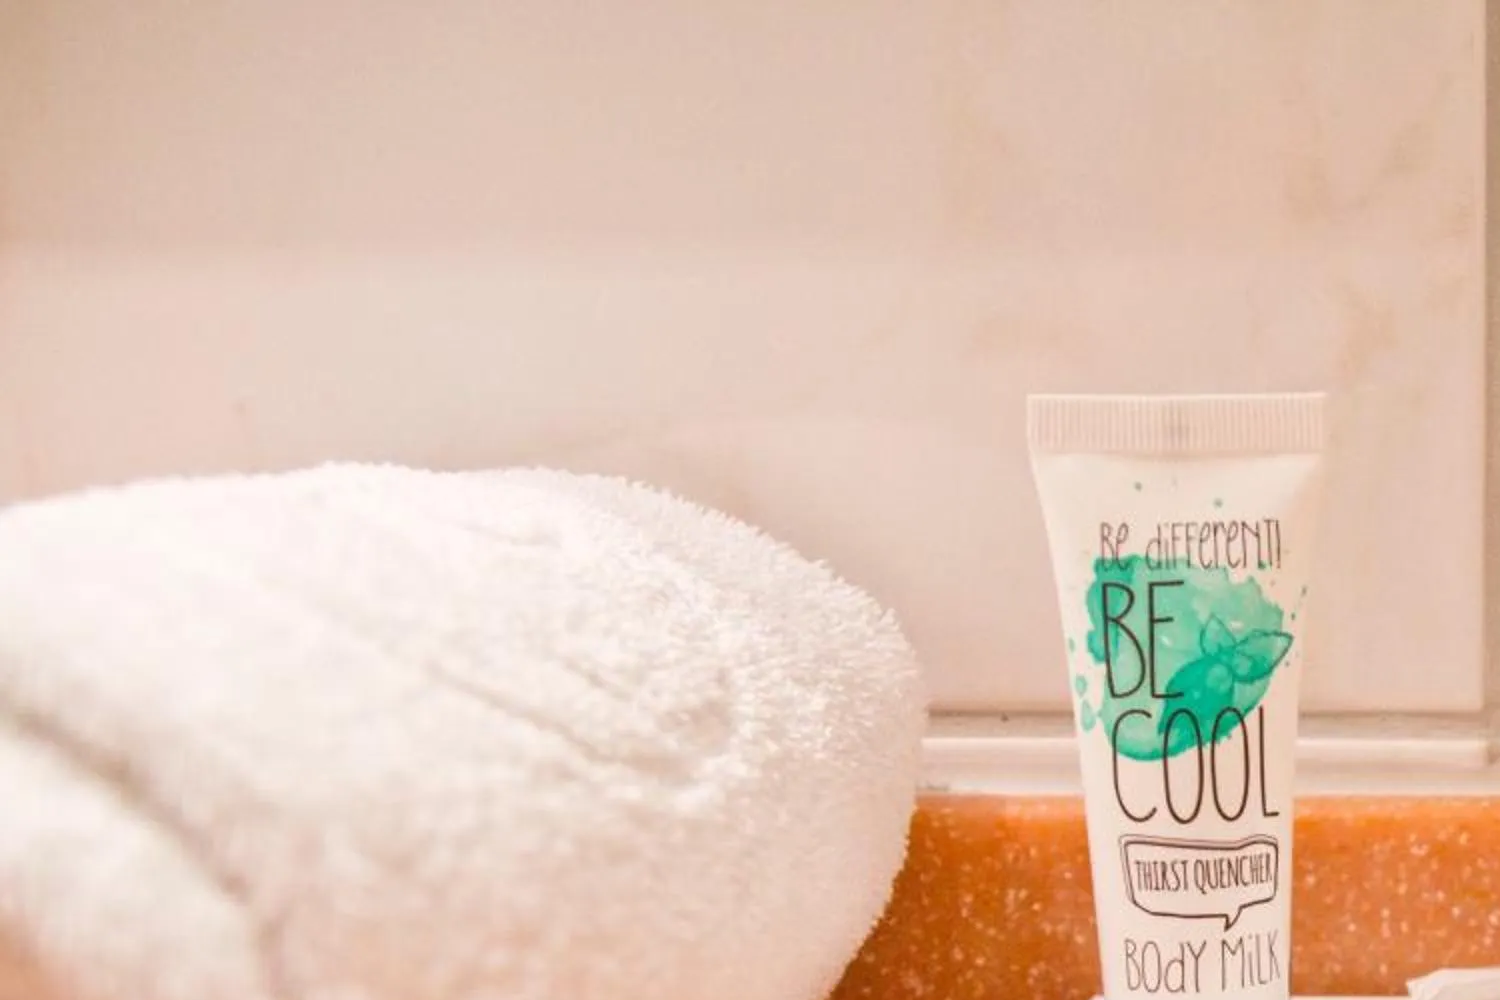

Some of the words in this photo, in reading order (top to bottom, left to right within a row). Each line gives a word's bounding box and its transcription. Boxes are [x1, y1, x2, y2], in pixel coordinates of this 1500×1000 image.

[1102, 580, 1184, 699] BE
[1112, 705, 1279, 824] COOL
[1134, 858, 1190, 892] THIRST
[1193, 852, 1273, 895] QUENCHER
